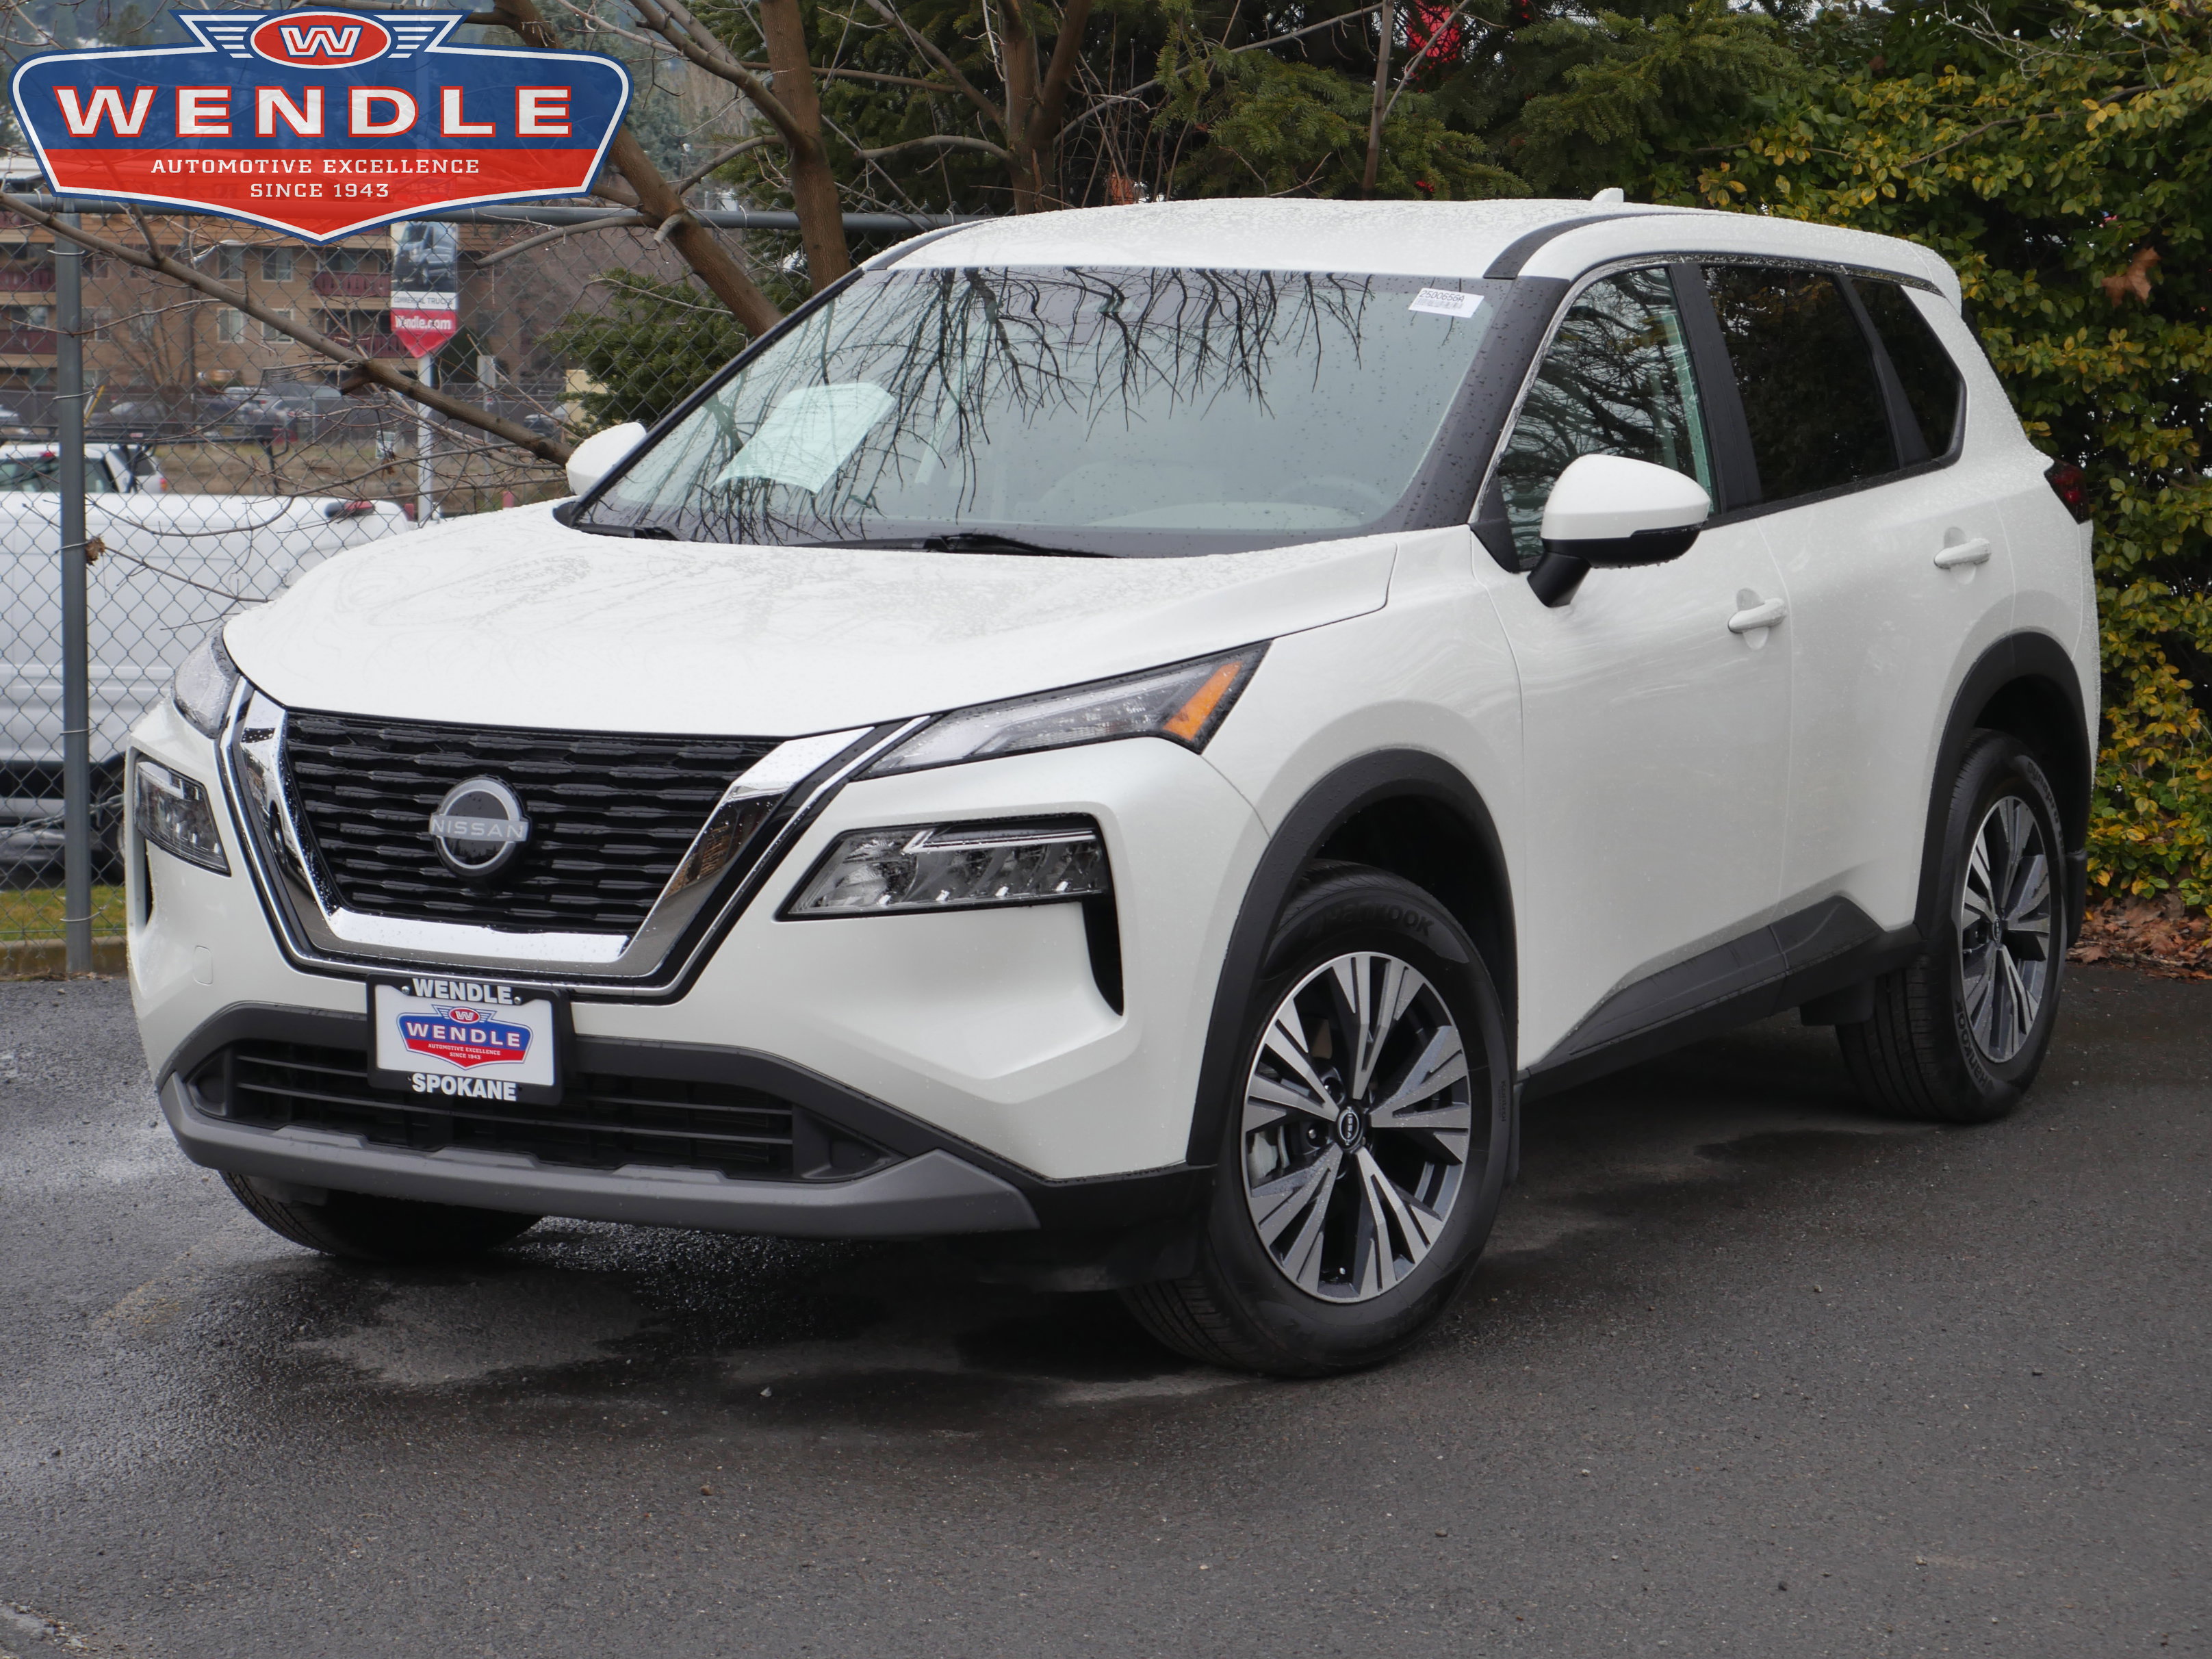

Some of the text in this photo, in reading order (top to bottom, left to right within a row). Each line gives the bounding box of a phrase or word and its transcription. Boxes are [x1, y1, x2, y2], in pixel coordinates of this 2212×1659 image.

[431, 819, 524, 838] NISSAN
[412, 978, 513, 1005] WENDLE
[406, 1021, 520, 1047] WENDLE
[428, 1043, 500, 1055] AUTOMOTIVE EXCELLENCE
[412, 1072, 517, 1102] SPOKANE
